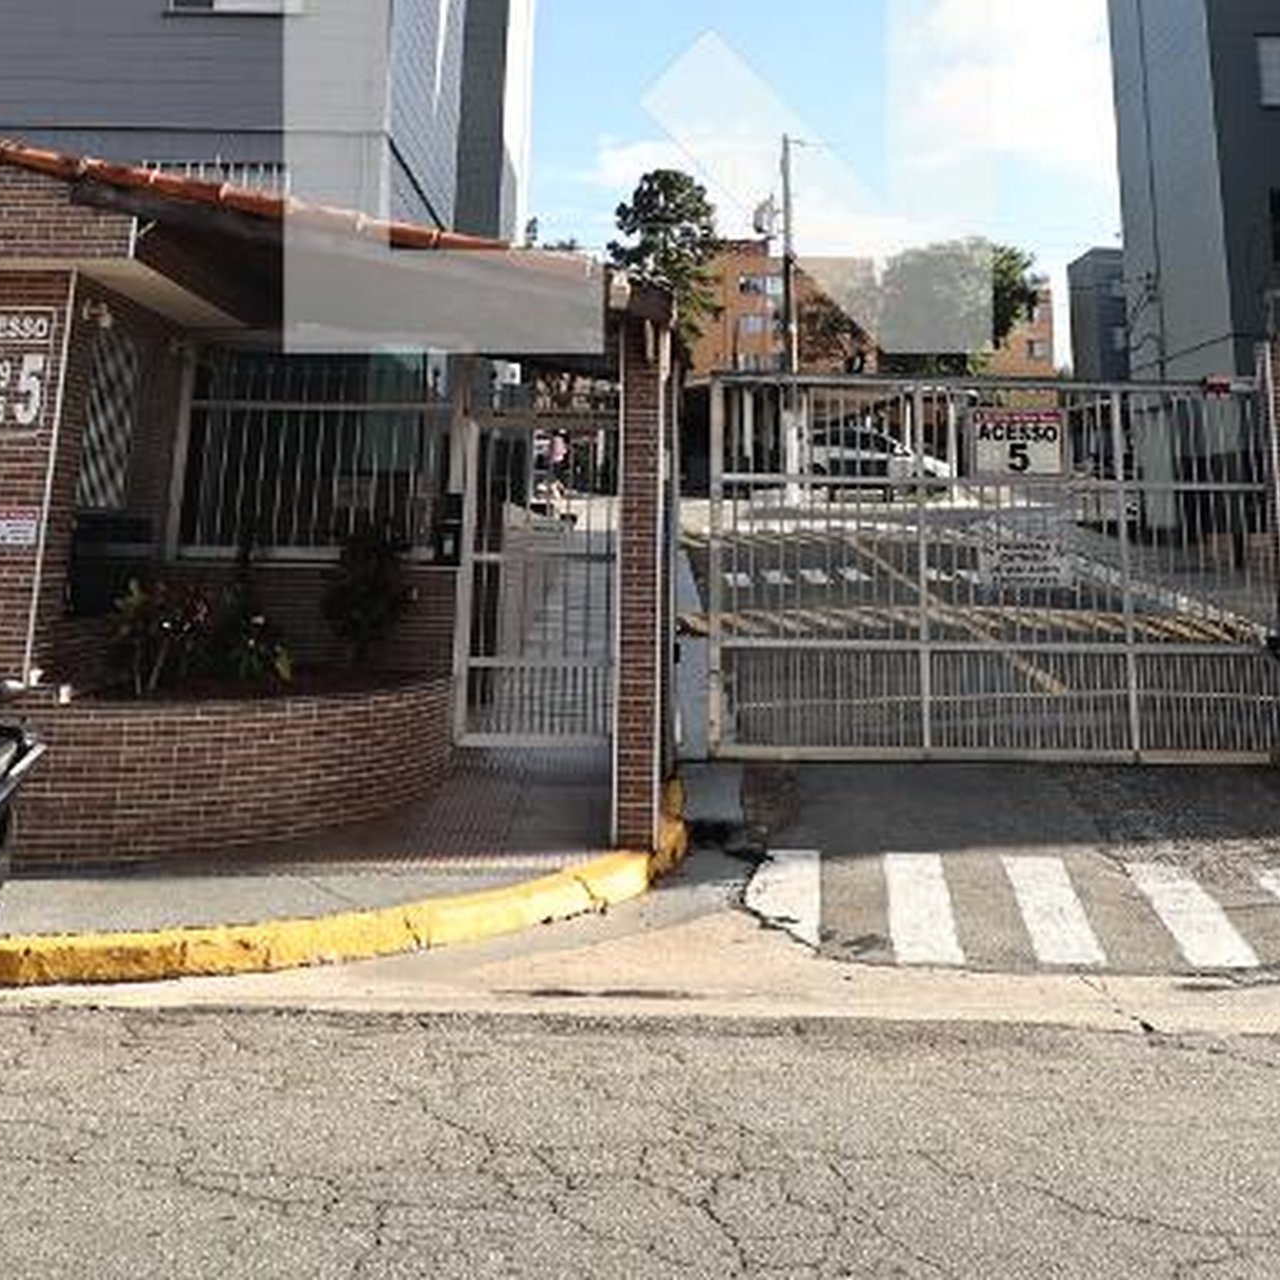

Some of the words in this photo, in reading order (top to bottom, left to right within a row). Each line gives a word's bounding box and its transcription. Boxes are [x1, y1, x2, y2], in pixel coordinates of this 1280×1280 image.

[14, 354, 44, 424] 5
[979, 424, 1058, 442] ACESSO
[1007, 443, 1031, 471] 5
